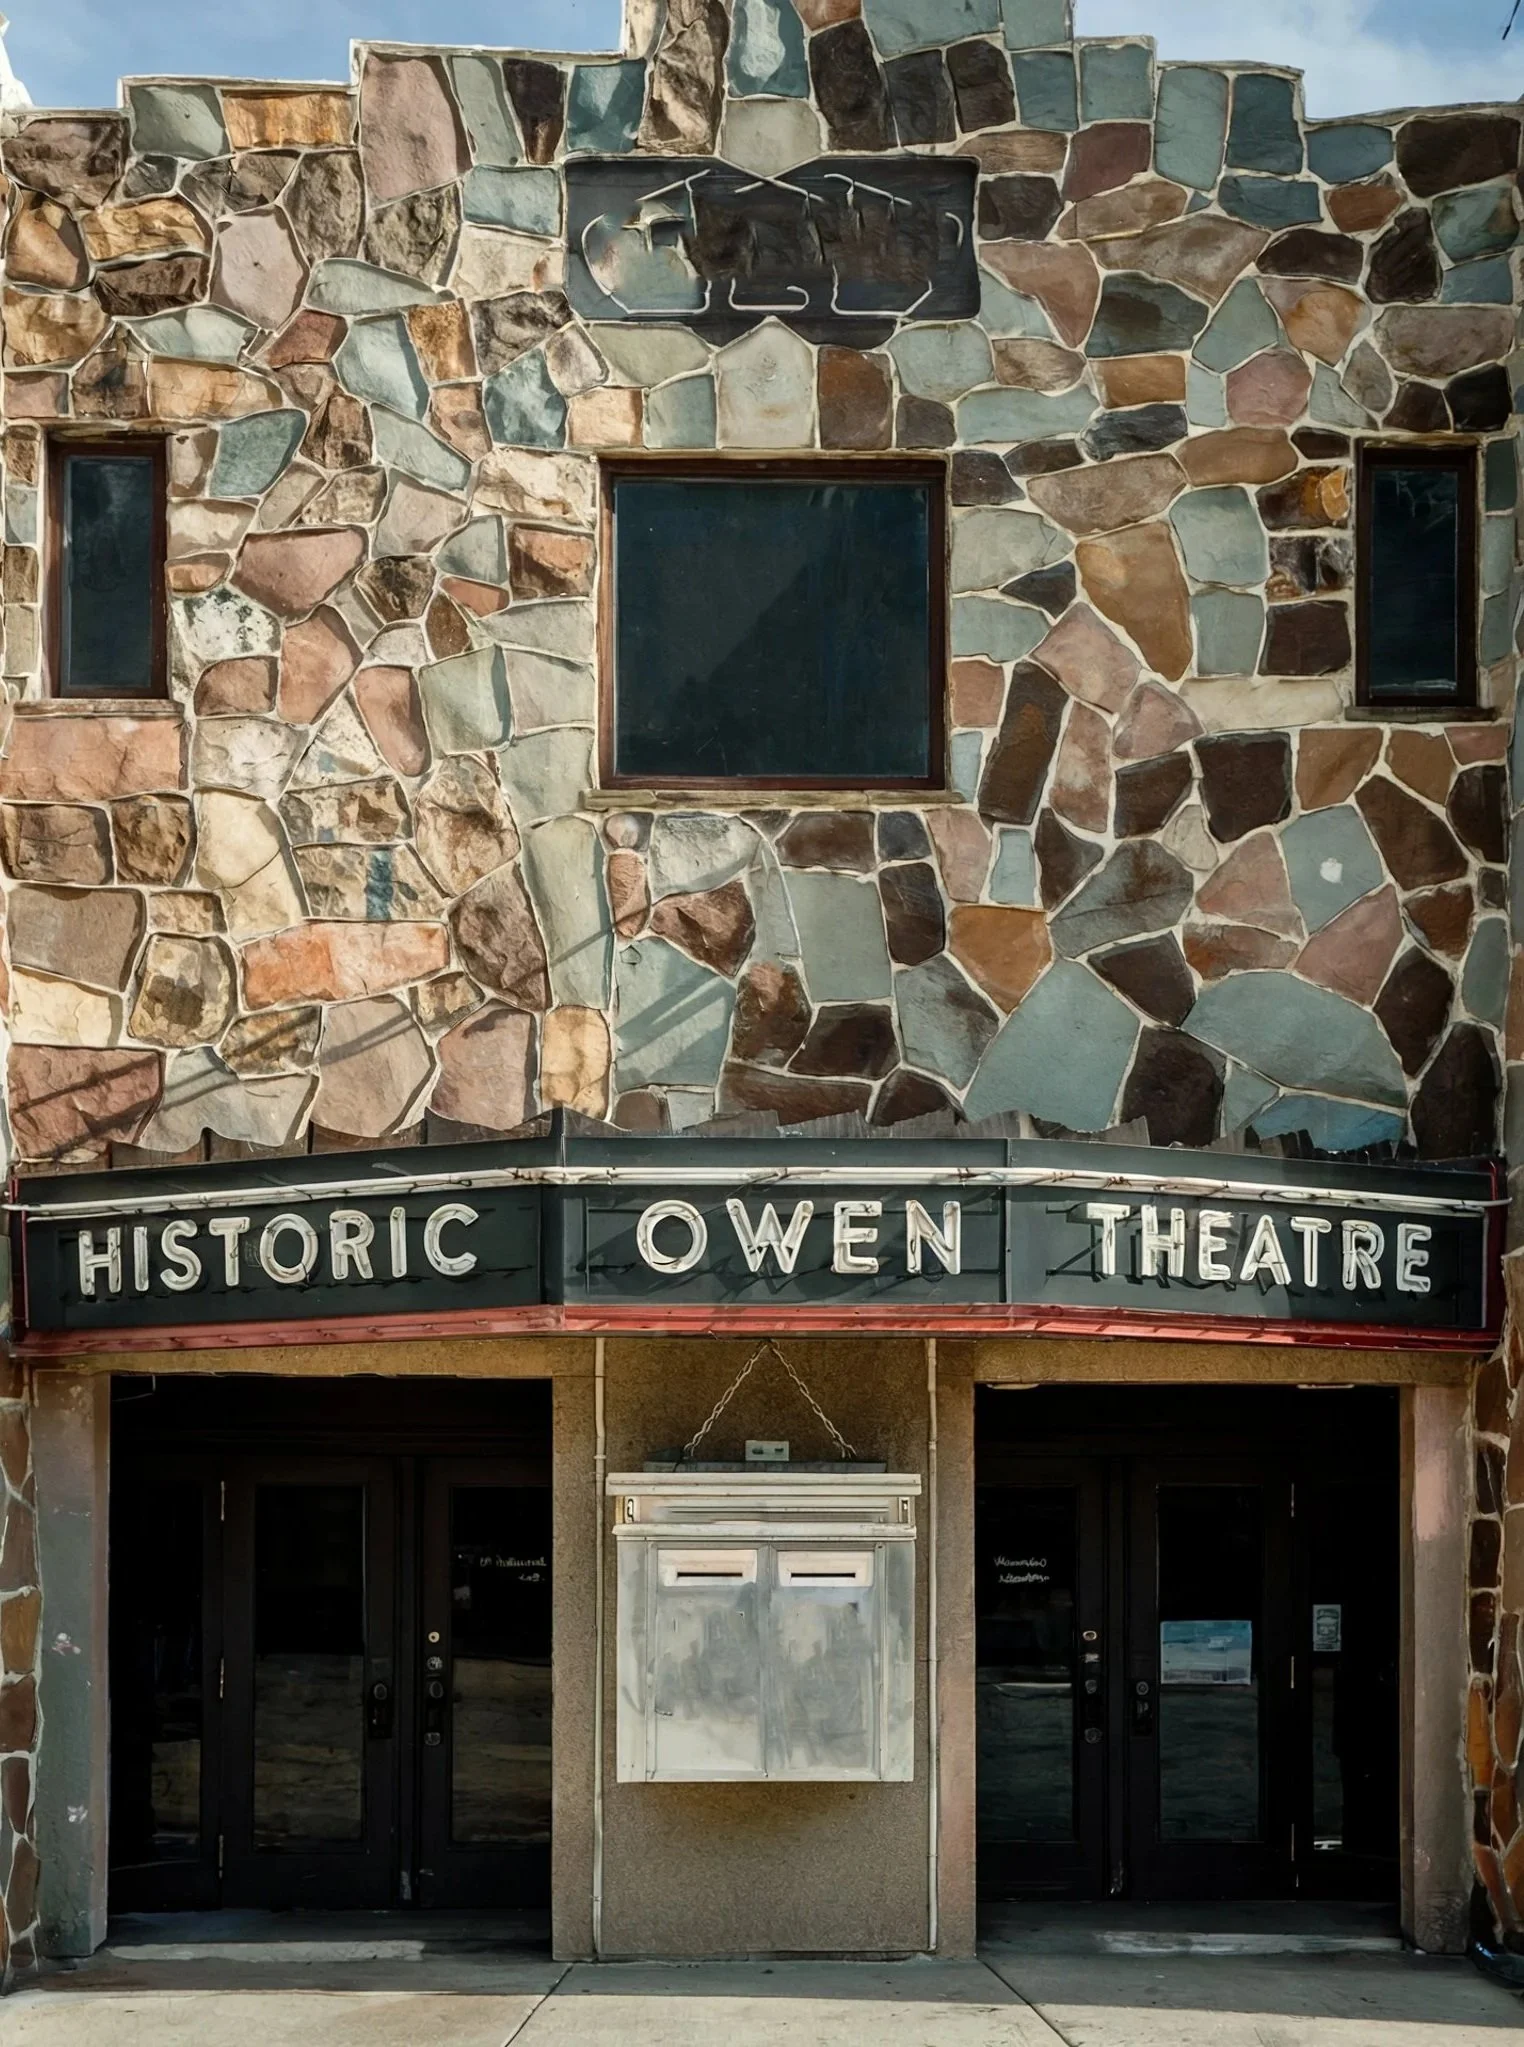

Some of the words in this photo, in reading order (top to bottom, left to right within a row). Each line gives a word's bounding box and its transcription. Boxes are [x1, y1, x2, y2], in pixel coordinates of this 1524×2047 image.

[78, 1203, 479, 1297] HISTORIC
[636, 1199, 962, 1276] OWEN
[1086, 1202, 1433, 1293] THEATRE
